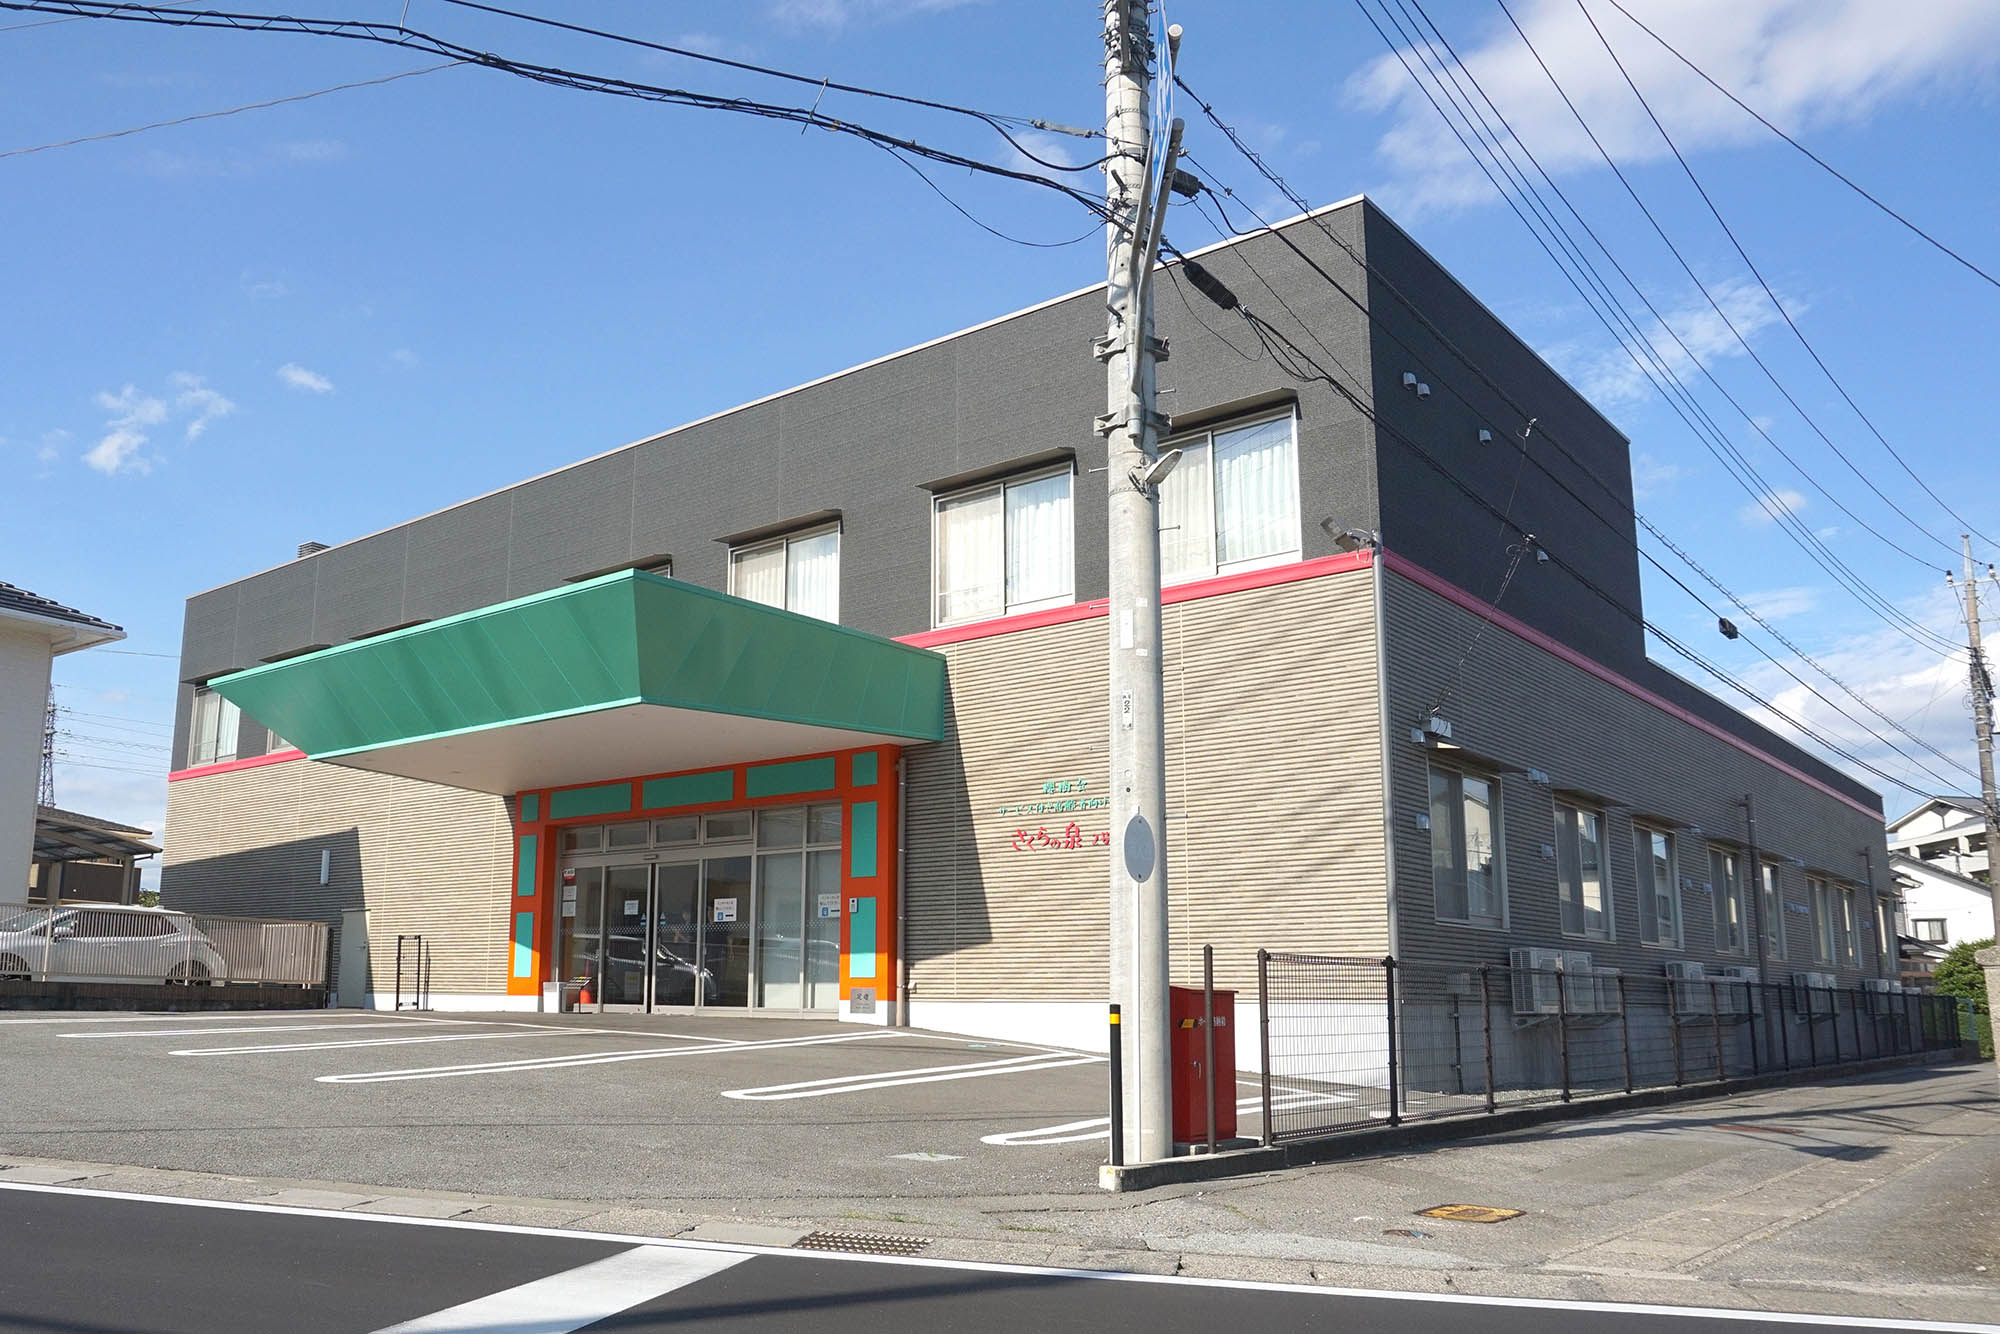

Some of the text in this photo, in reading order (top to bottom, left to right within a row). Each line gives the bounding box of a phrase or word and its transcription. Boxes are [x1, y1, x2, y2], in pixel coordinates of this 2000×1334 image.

[1011, 821, 1083, 851] さくらの泉
